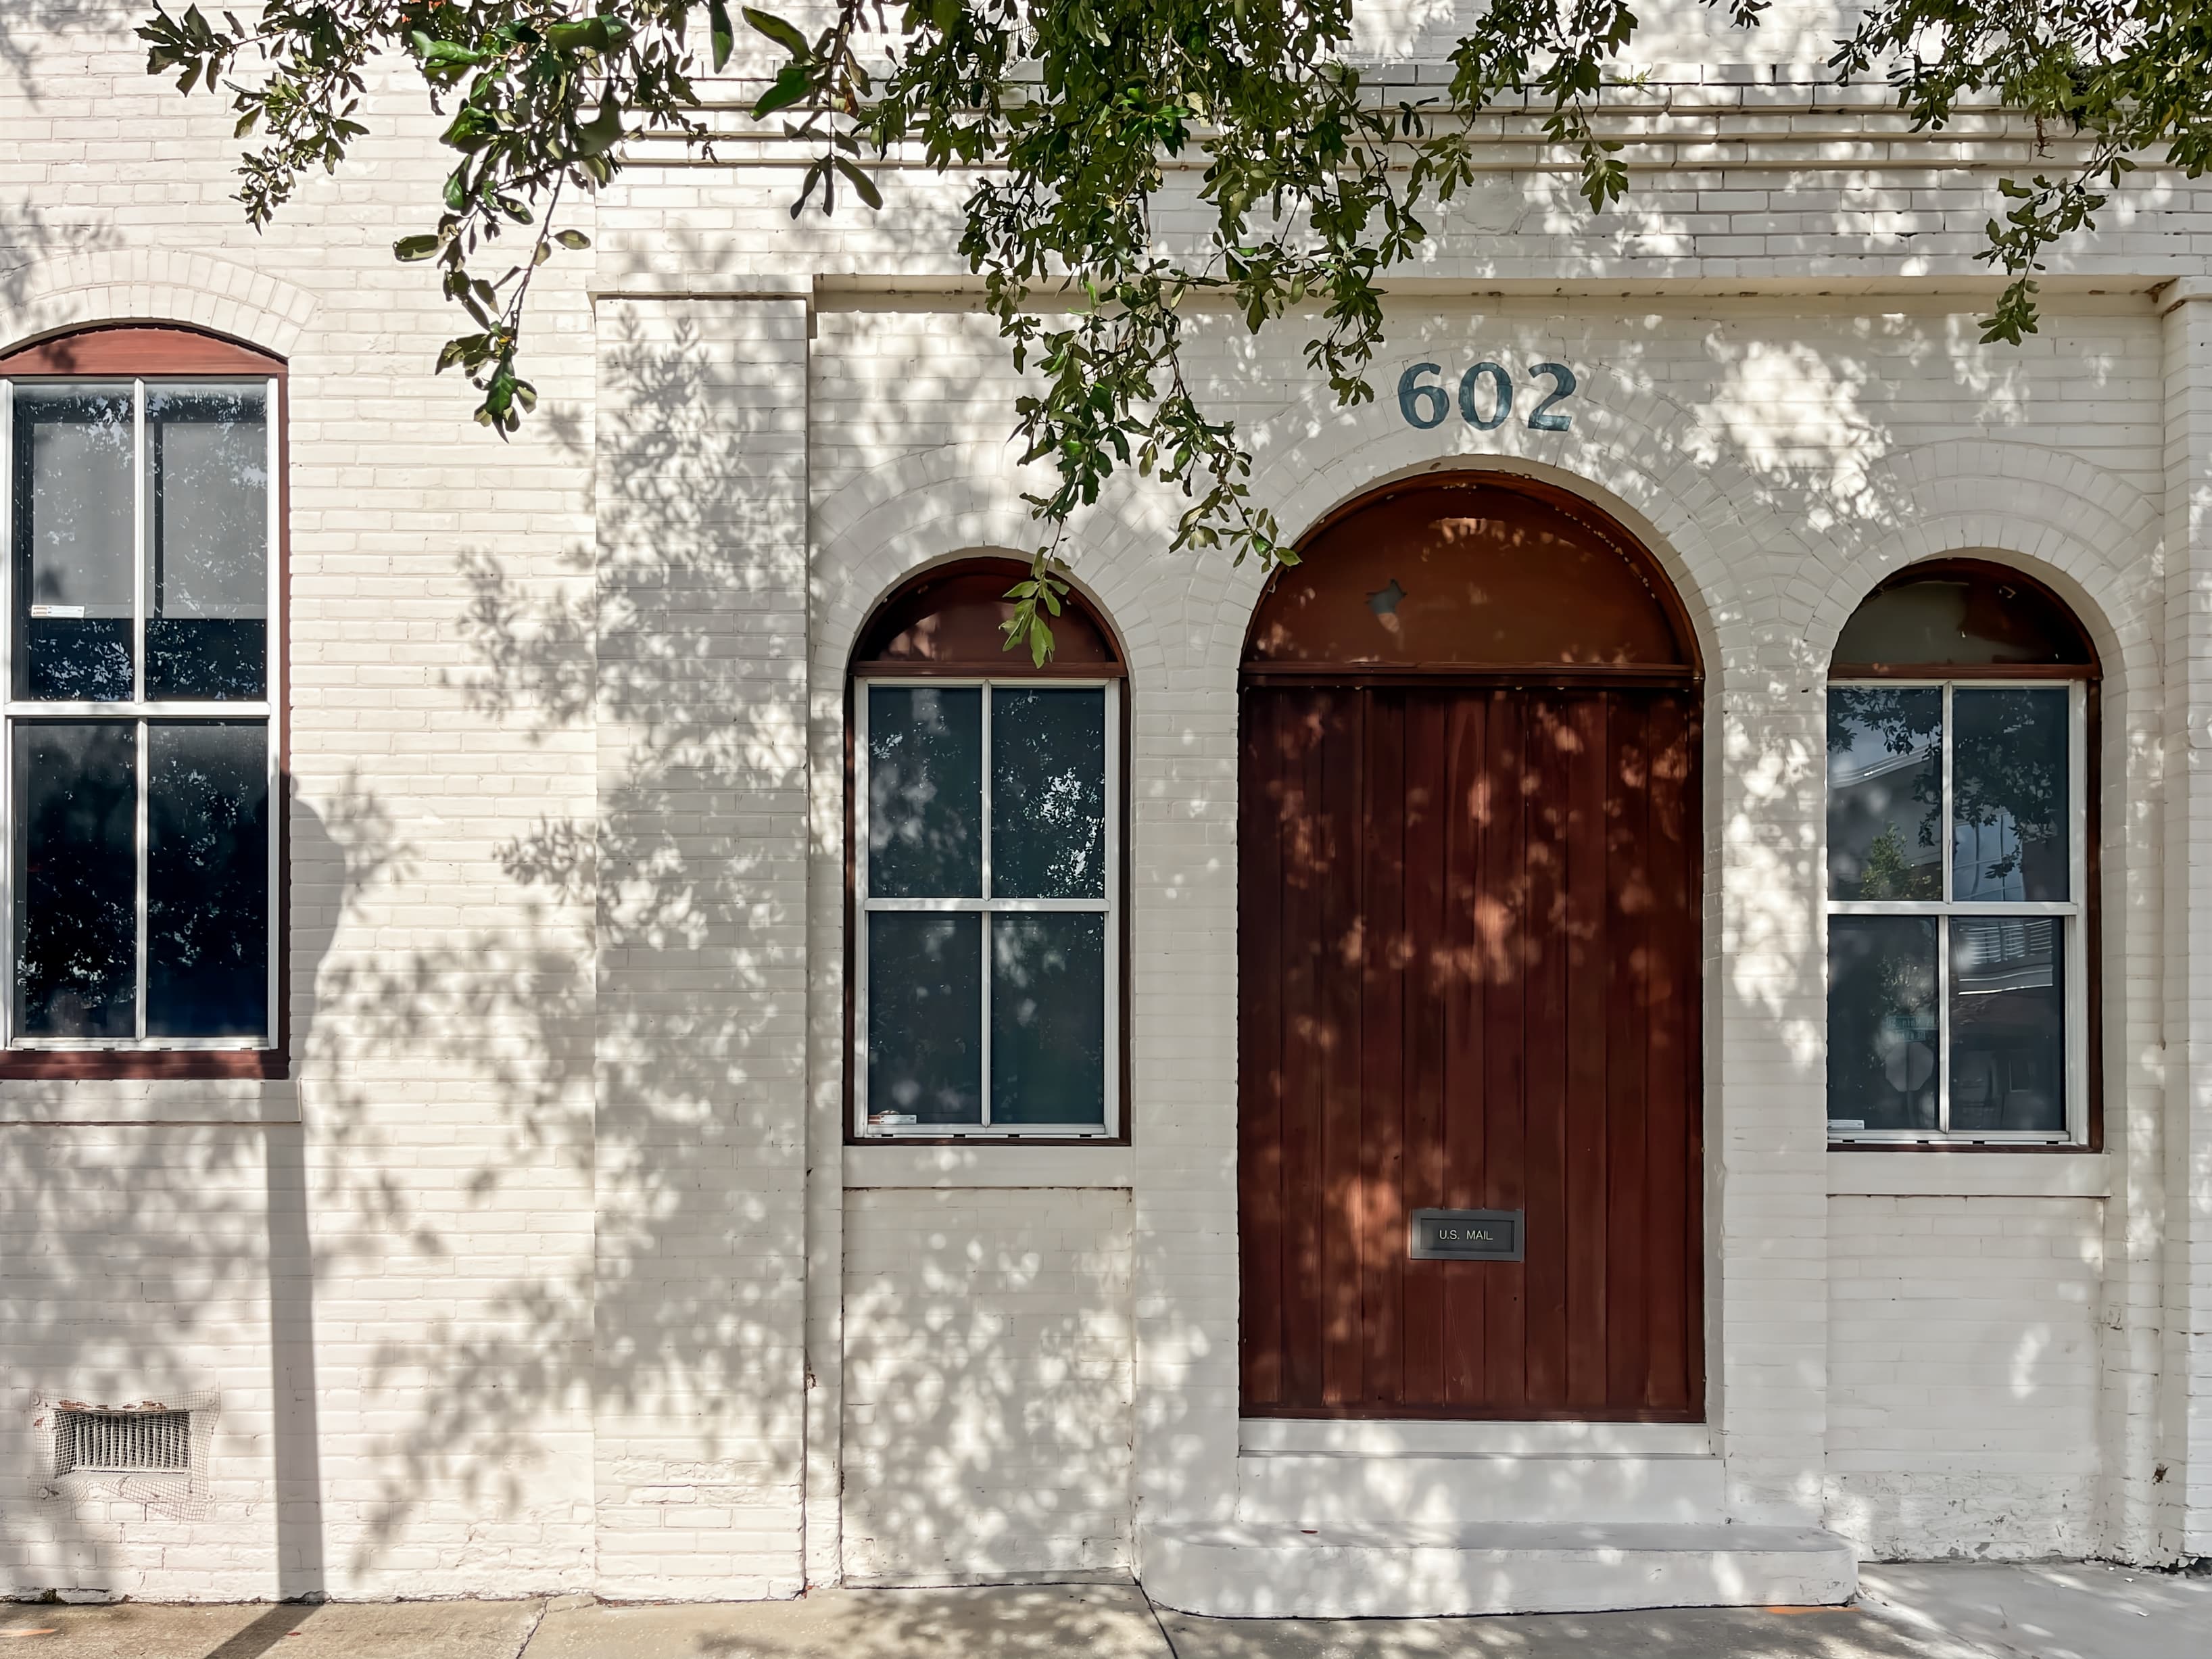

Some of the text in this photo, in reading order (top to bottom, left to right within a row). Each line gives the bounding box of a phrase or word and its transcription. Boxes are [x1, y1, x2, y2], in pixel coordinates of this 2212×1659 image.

[1397, 362, 1577, 431] 602
[1439, 1229, 1493, 1241] U.S. MAIL
